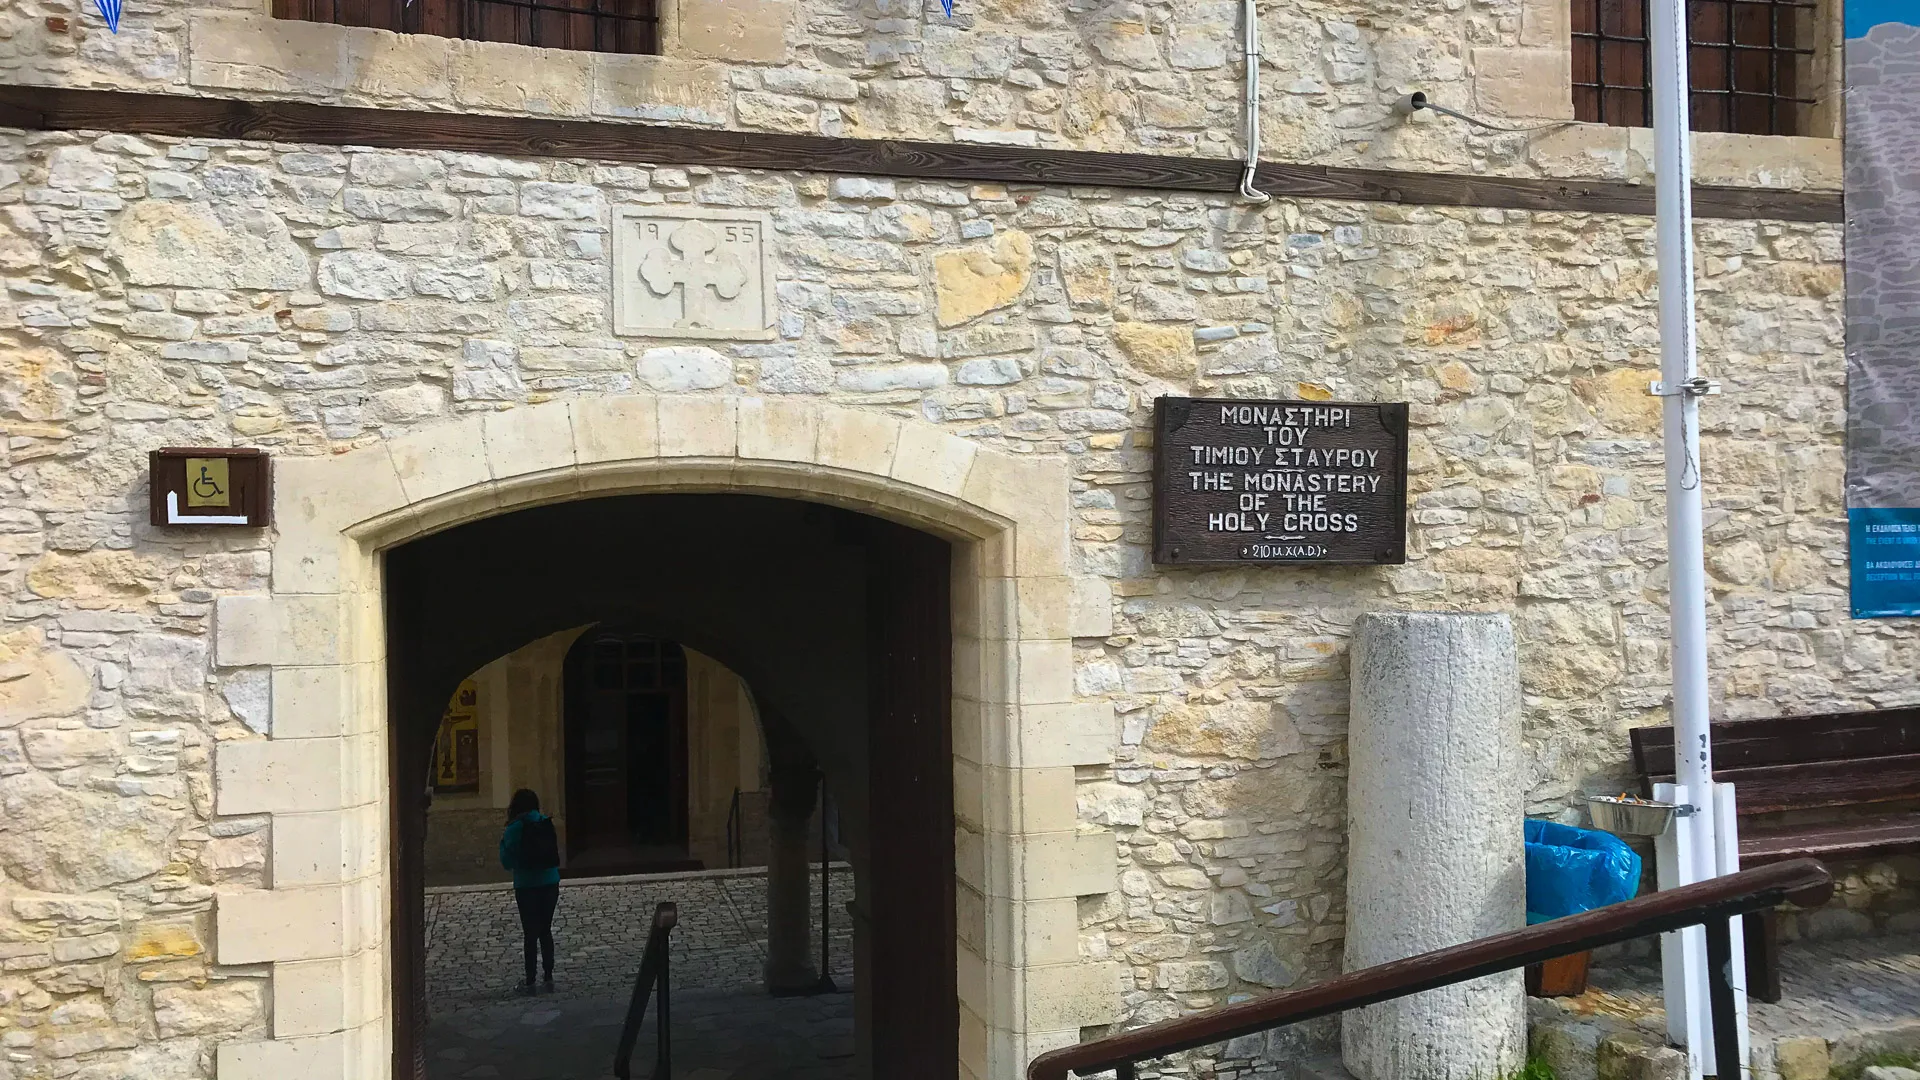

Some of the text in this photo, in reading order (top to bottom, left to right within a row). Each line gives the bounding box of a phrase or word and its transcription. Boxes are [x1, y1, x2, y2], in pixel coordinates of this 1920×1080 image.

[635, 222, 754, 243] 19 55
[1220, 406, 1350, 427] ΜΟΝΑΣΤΗΡΙ
[1263, 427, 1309, 446] ΤΟΥ
[1190, 446, 1379, 468] ΤΙΜΙΟΥ ΣΤΑΥΡΟΥ
[1188, 472, 1381, 493] THE MONASTERY
[1239, 494, 1327, 512] OF THE
[1208, 513, 1358, 533] HOLY CROSS
[1252, 544, 1271, 559] 210
